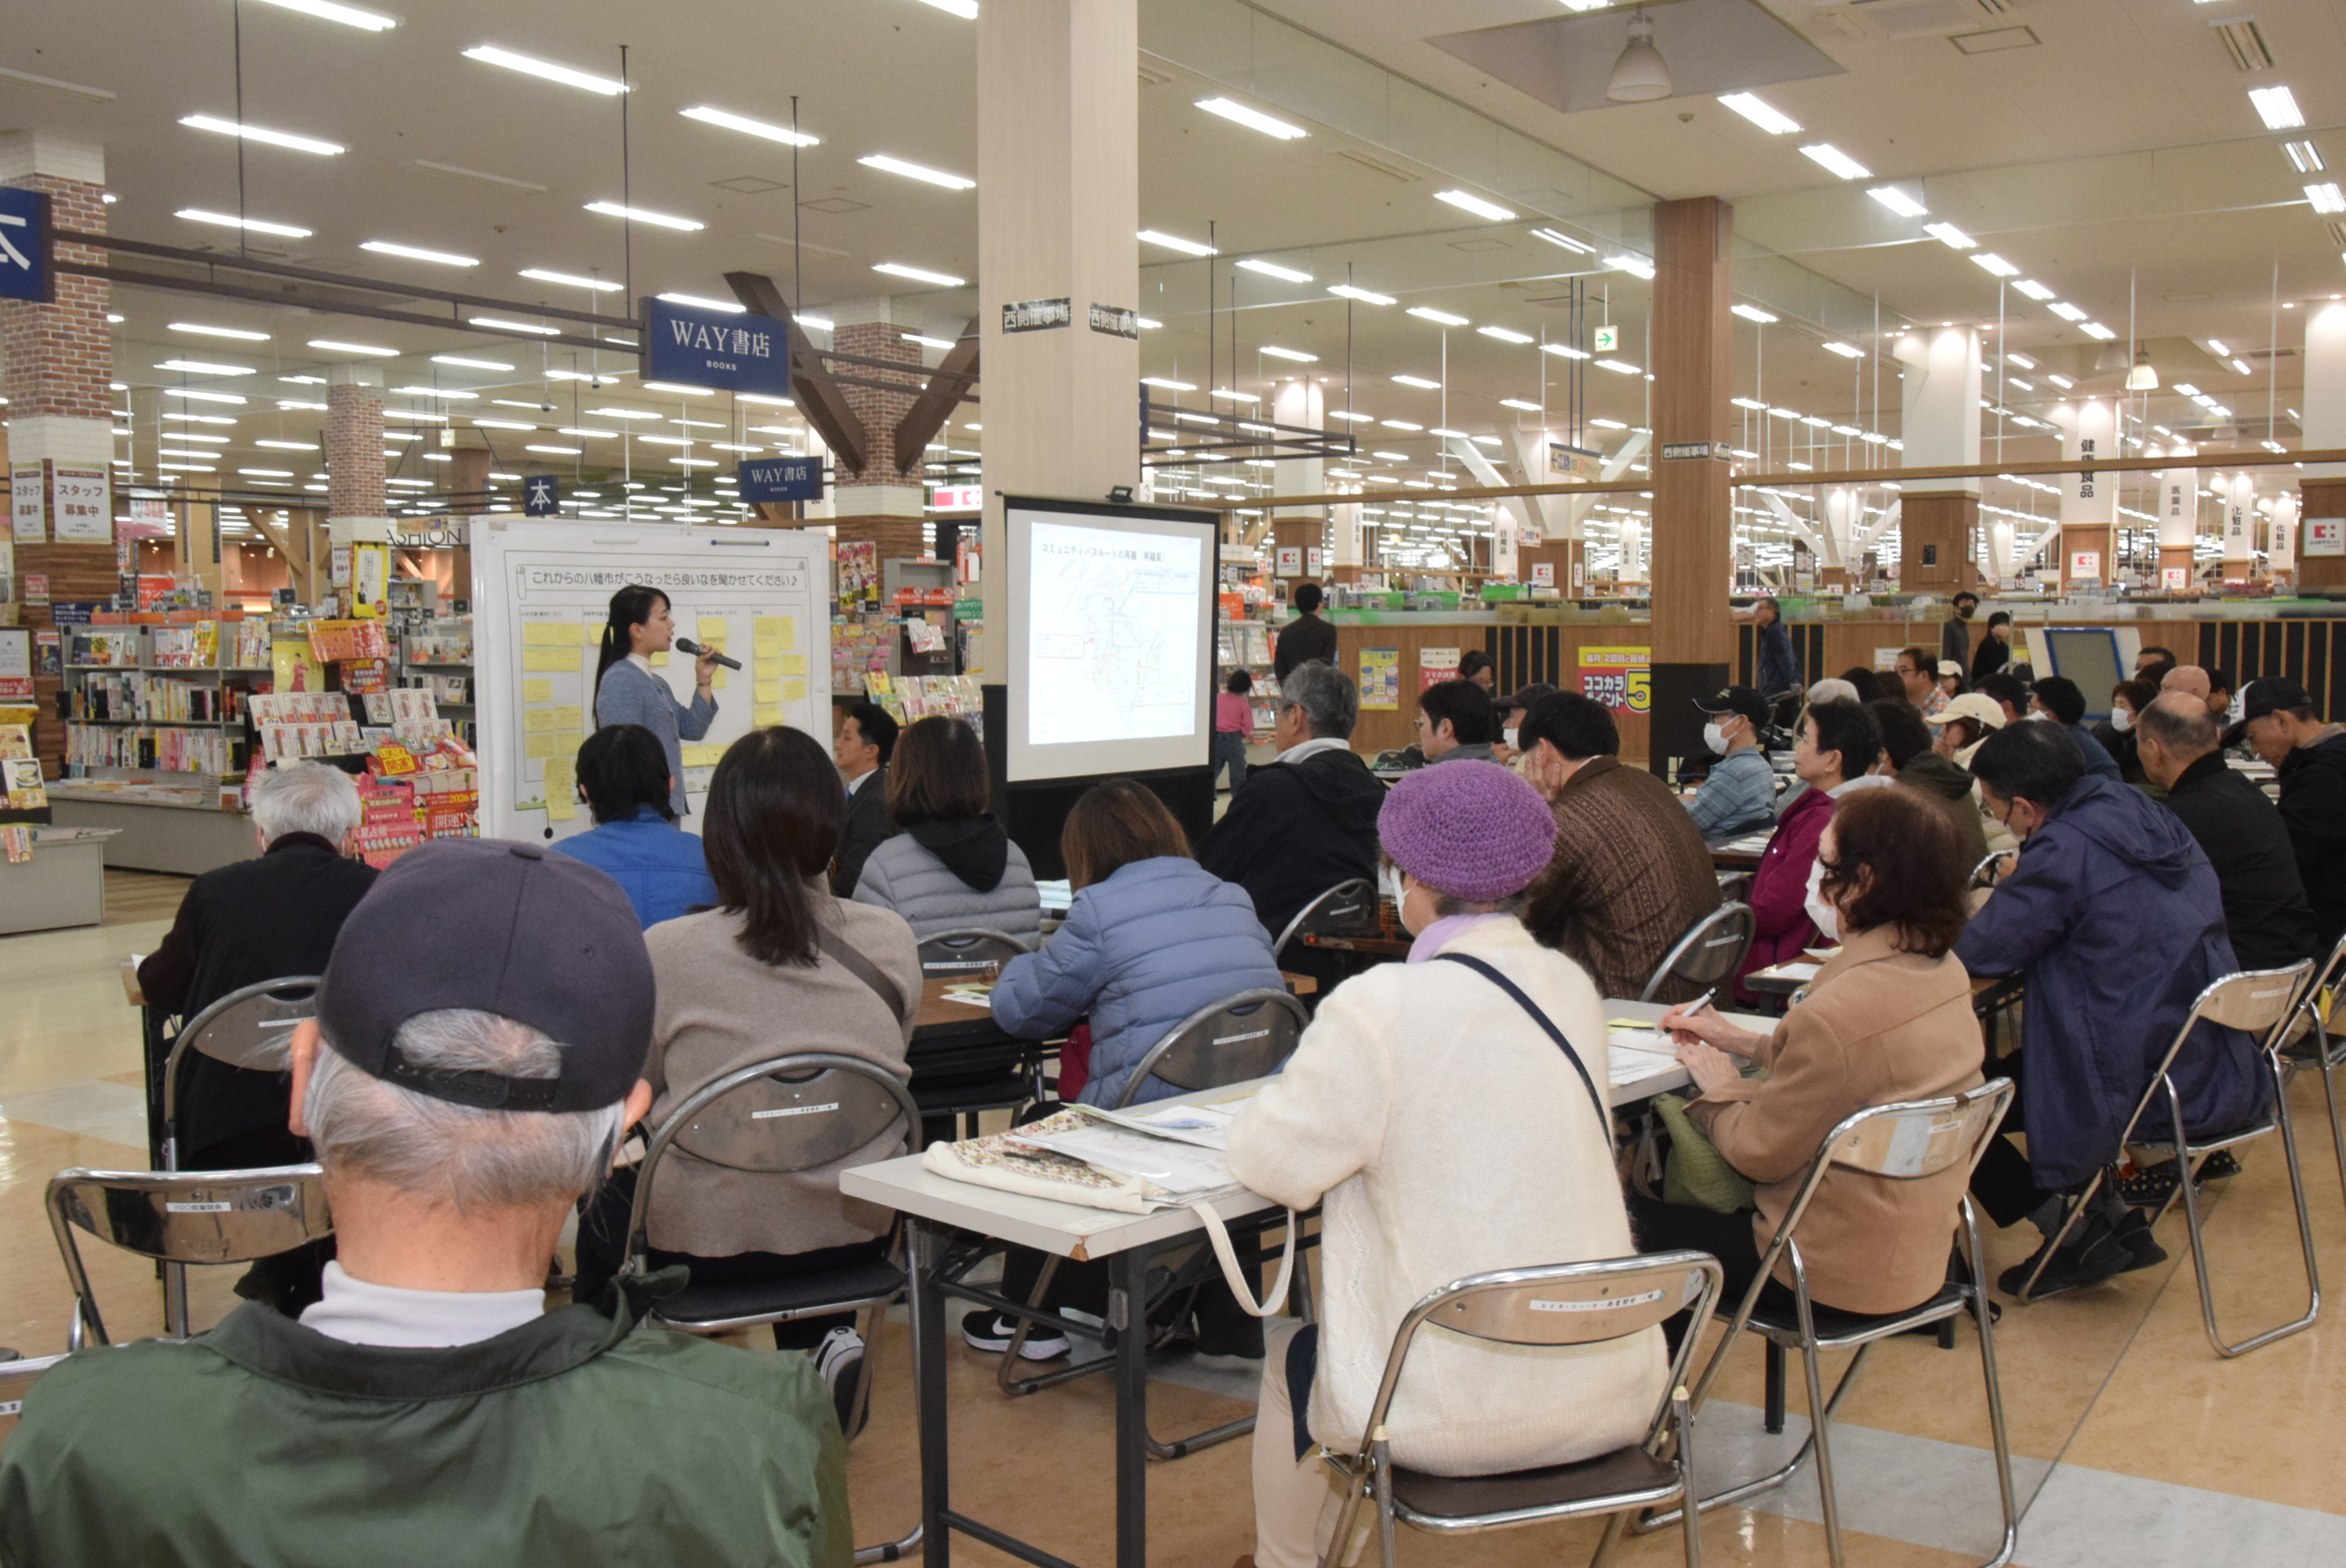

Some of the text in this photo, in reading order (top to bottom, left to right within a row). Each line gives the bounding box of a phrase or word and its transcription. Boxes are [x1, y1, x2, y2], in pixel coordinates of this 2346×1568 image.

[670, 318, 770, 358] WAY書店
[706, 360, 737, 372] BOOKS
[751, 466, 807, 483] WAY書店
[59, 485, 104, 497] スタッフ
[531, 479, 551, 510] 本
[2170, 485, 2181, 517] 医薬品
[65, 503, 99, 517] 募集中
[2231, 506, 2242, 536] 化粧品
[2275, 524, 2286, 550] 化粧品
[2014, 578, 2025, 588] 15
[1584, 675, 1625, 691] ココカラ
[1627, 670, 1651, 713] 5
[449, 793, 470, 804] 2026
